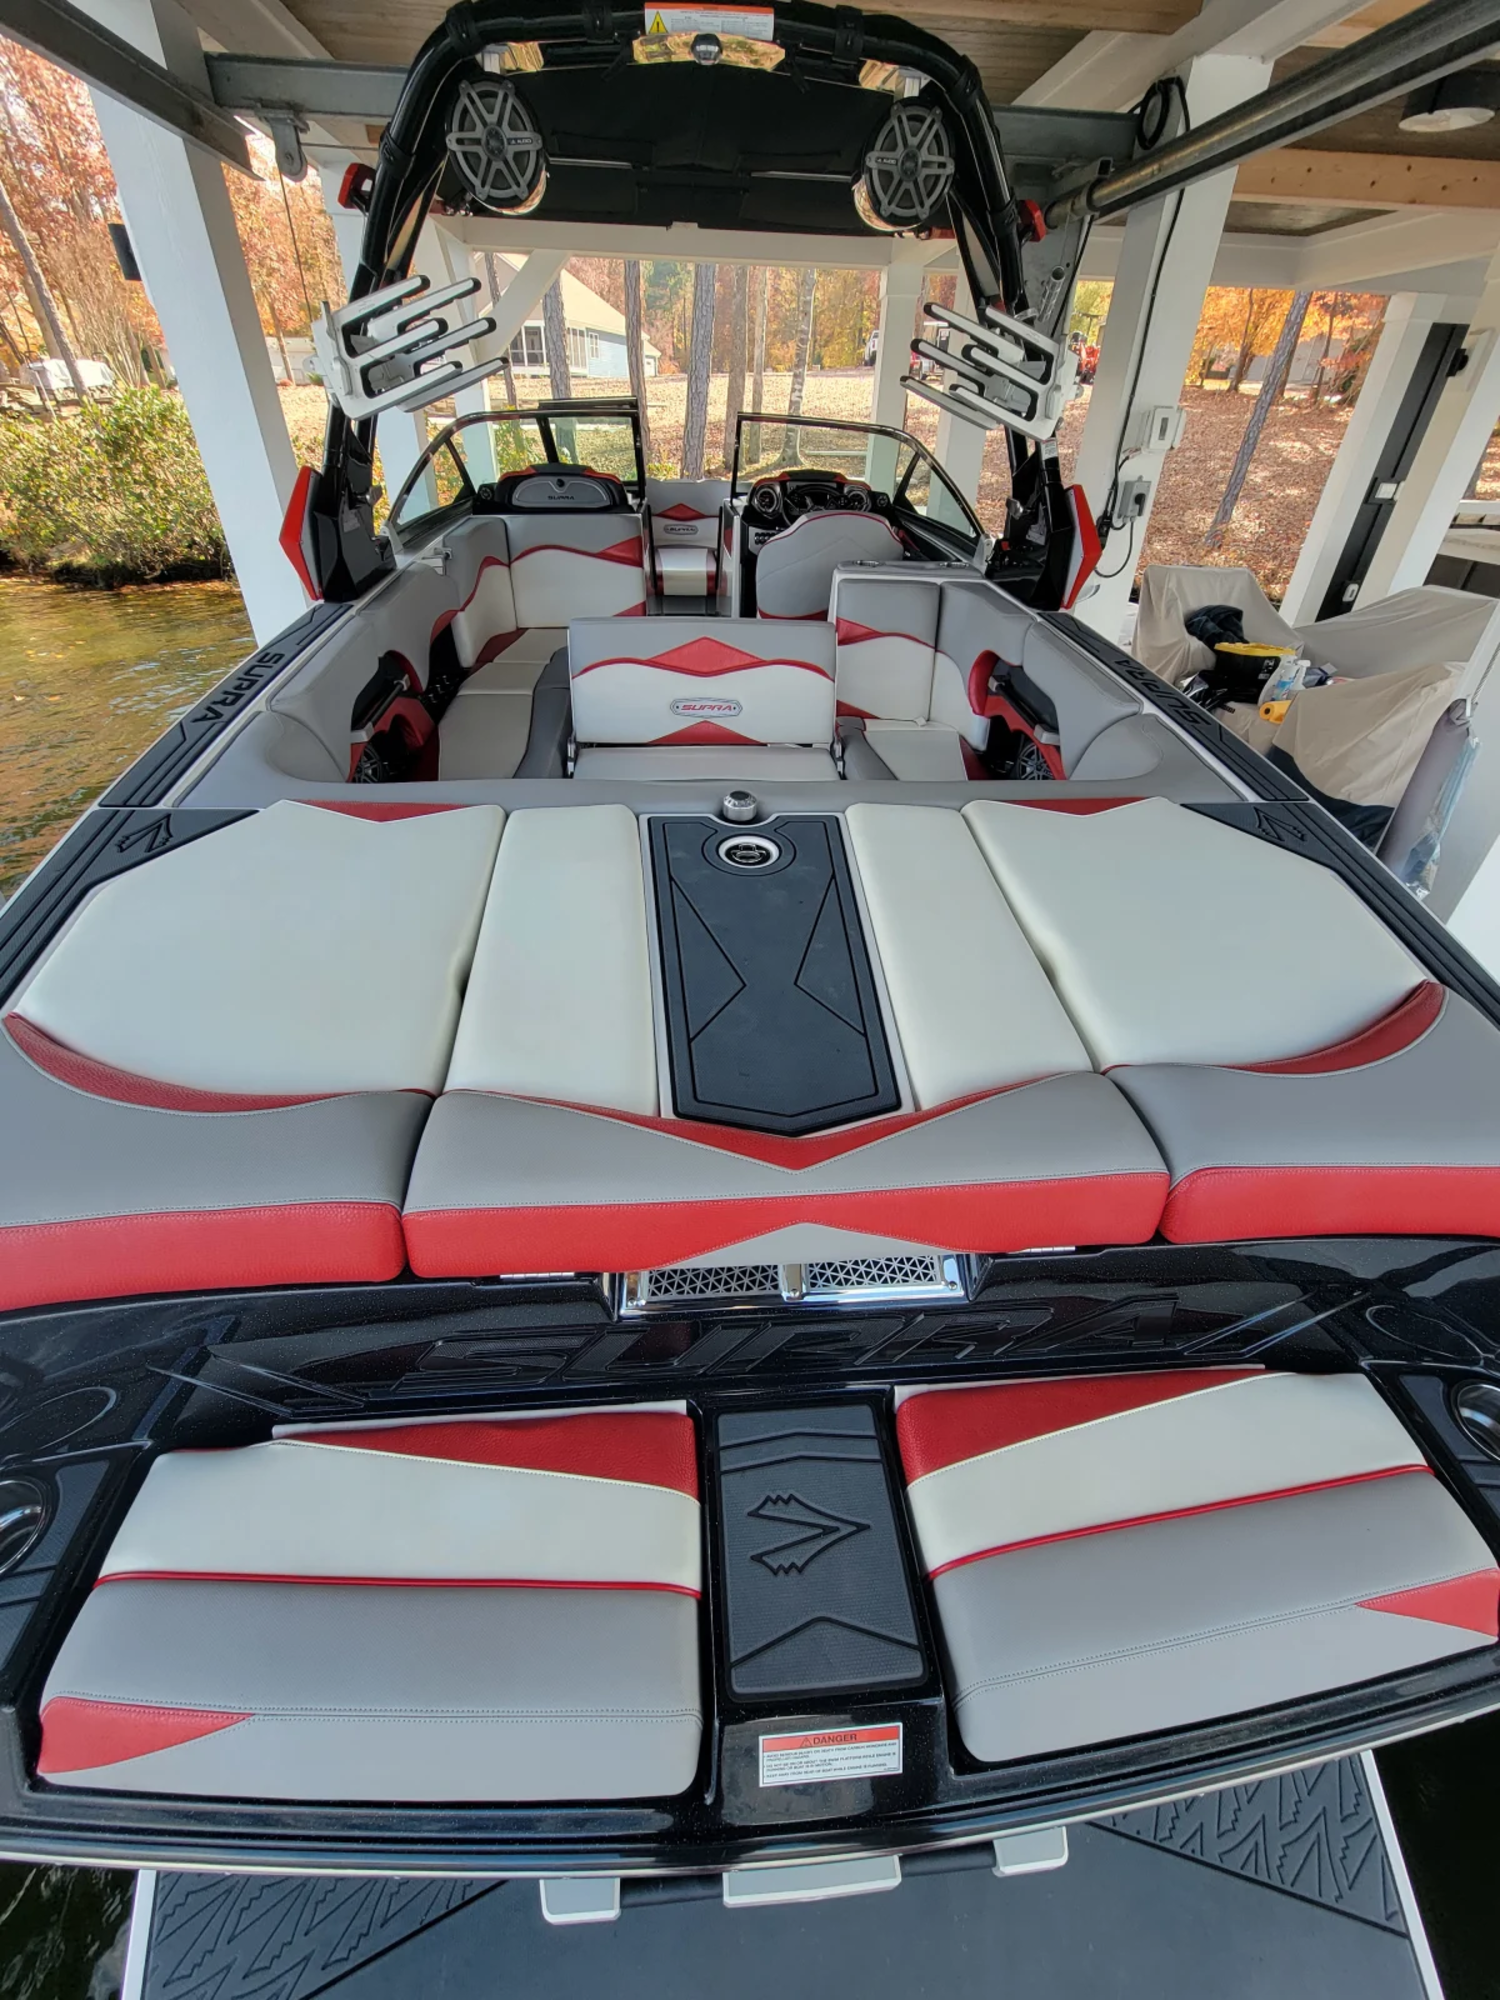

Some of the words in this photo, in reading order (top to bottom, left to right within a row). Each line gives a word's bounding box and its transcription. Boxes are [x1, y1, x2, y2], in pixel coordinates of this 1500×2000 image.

[190, 652, 286, 723] SUPRA
[680, 704, 732, 712] SUPRA
[1114, 660, 1212, 726] SUPRA
[391, 1293, 1179, 1391] SUPRA
[813, 1733, 858, 1745] DANGER
